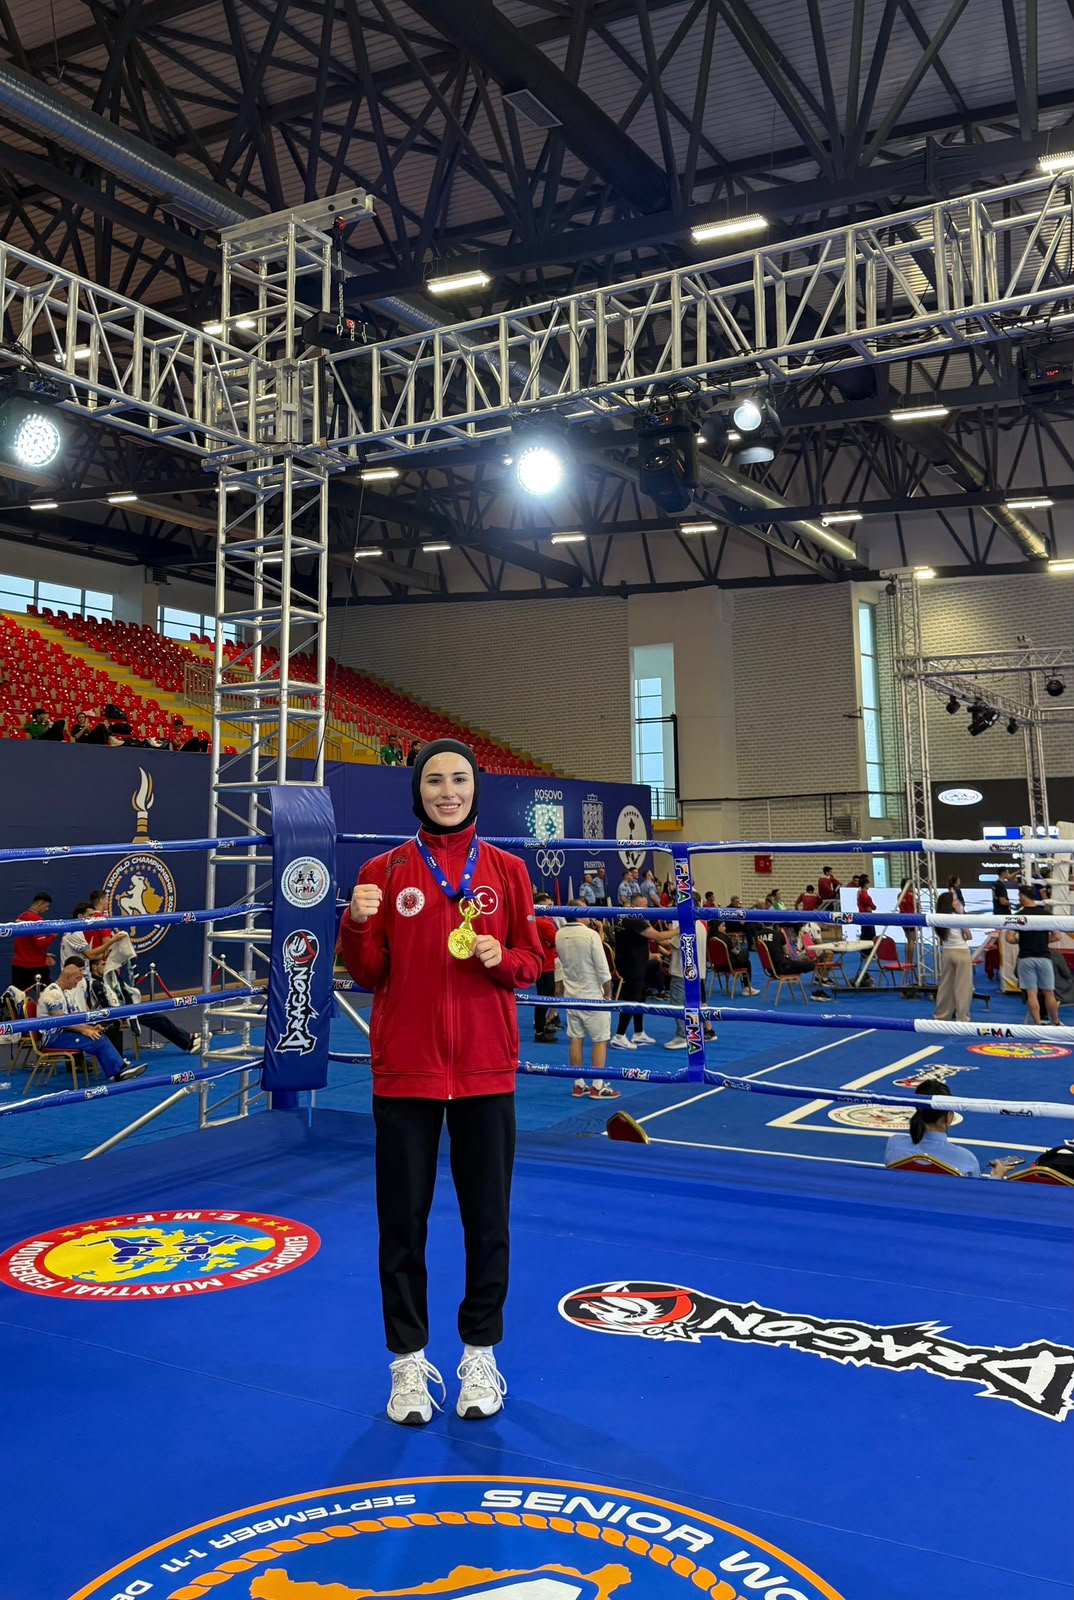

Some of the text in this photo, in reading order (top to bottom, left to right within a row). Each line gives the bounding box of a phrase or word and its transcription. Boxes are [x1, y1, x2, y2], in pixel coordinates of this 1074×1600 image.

[534, 789, 563, 801] KOSOVO
[108, 861, 130, 887] WORLD
[132, 857, 173, 893] CHAMPIONSHIP
[675, 858, 691, 903] IFMA
[174, 995, 197, 1007] IFMA
[280, 967, 312, 1049] DRAGON
[685, 1008, 702, 1054] IFMA
[977, 1028, 1015, 1038] IFMA
[8, 1234, 308, 1296] EUROPEAN MUAYTHAI FEDERATION
[697, 1308, 1074, 1405] DRAGON
[208, 1493, 416, 1550] SEPTEMBER
[480, 1489, 715, 1553] SENIOR
[160, 1548, 208, 1573] 1-11
